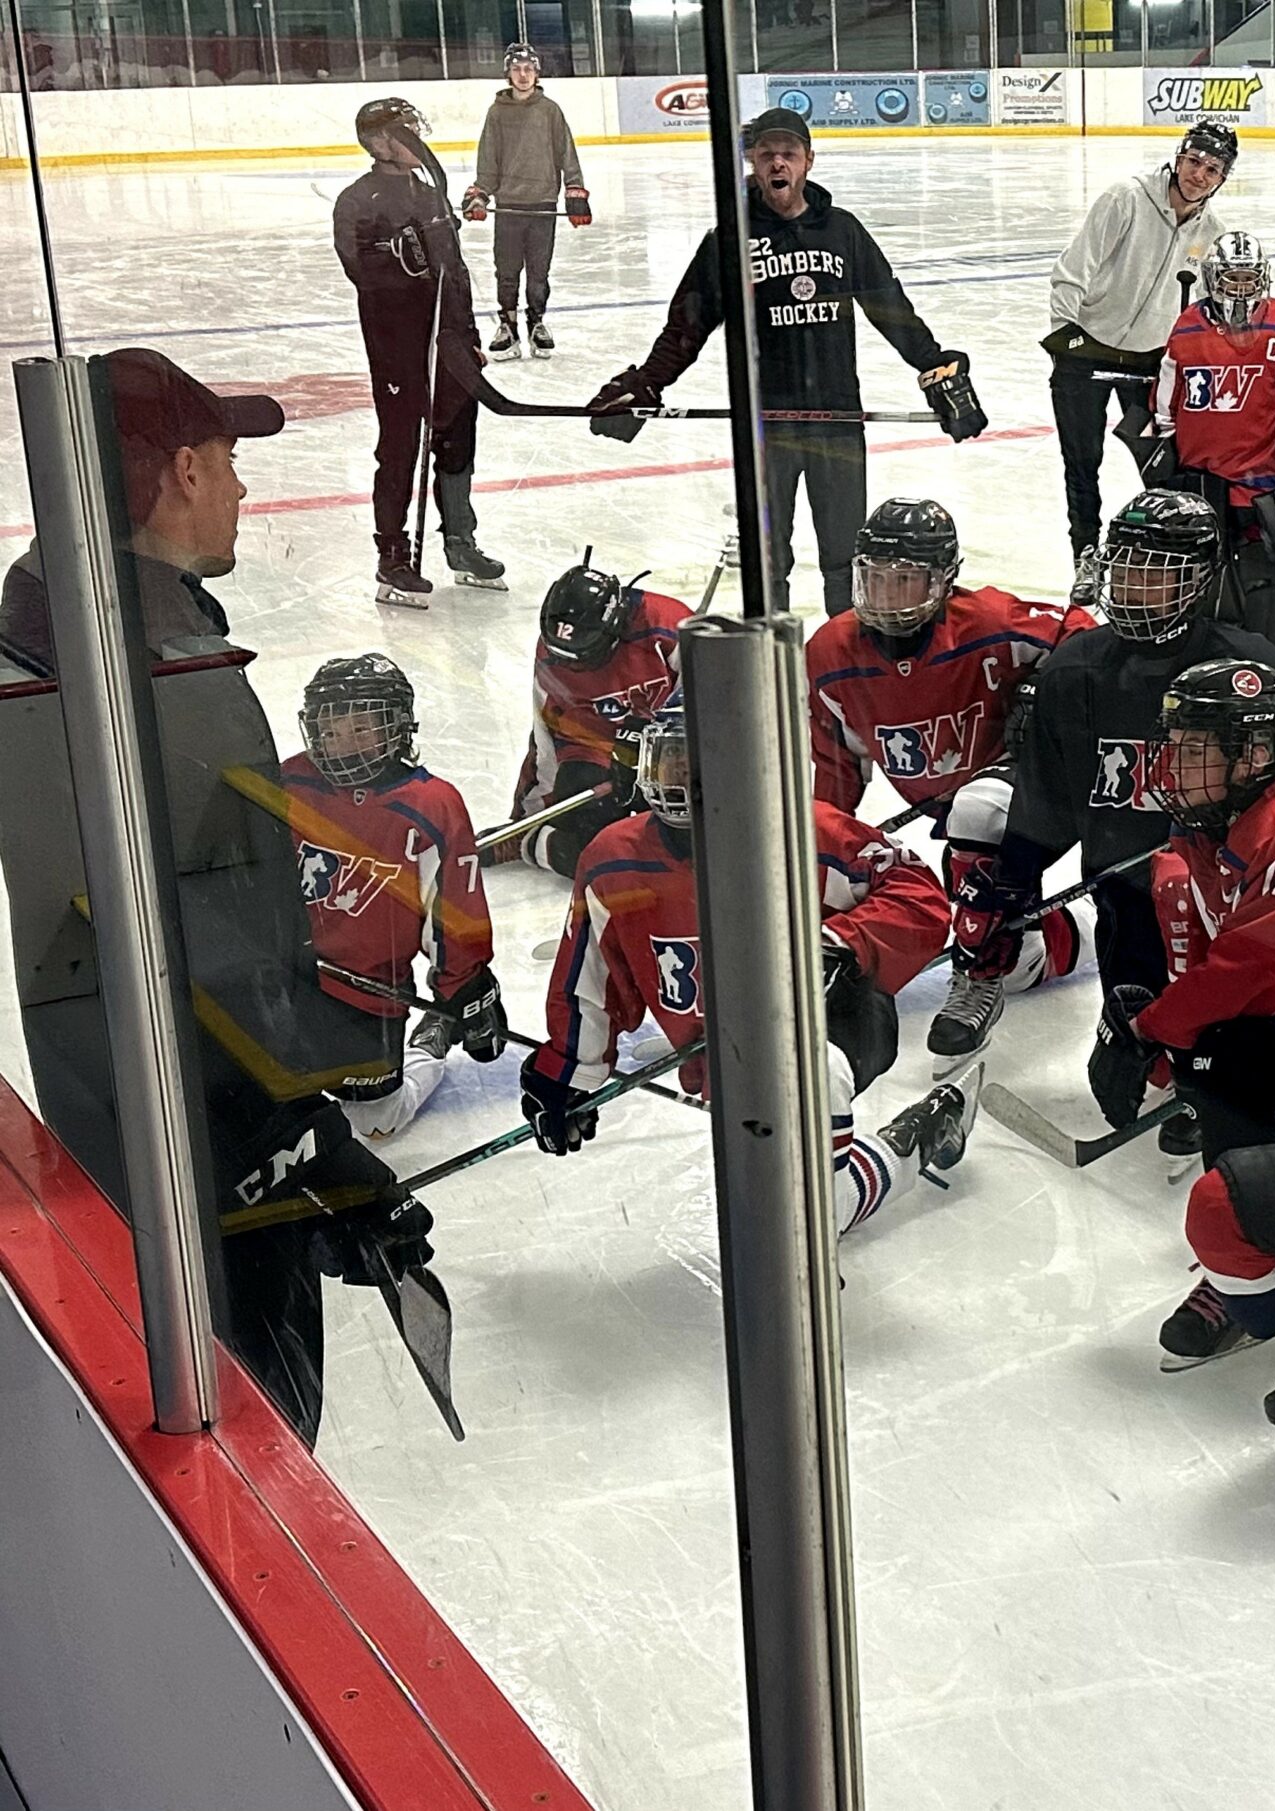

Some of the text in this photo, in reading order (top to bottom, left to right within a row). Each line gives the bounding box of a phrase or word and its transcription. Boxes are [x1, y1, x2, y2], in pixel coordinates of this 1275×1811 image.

[834, 79, 897, 87] CONSTRUCTION
[1147, 73, 1263, 115] SUBWAY
[1175, 113, 1240, 123] LAKE COWICHAN
[751, 250, 844, 284] BOMBERS
[769, 302, 840, 326] HOCKEY
[1183, 365, 1265, 412] BW
[557, 621, 574, 641] 12
[1155, 622, 1188, 644] CCM
[982, 657, 1000, 691] C
[1243, 713, 1275, 723] CCM
[875, 701, 985, 780] BW
[297, 840, 401, 917] BW
[458, 854, 479, 893] 7
